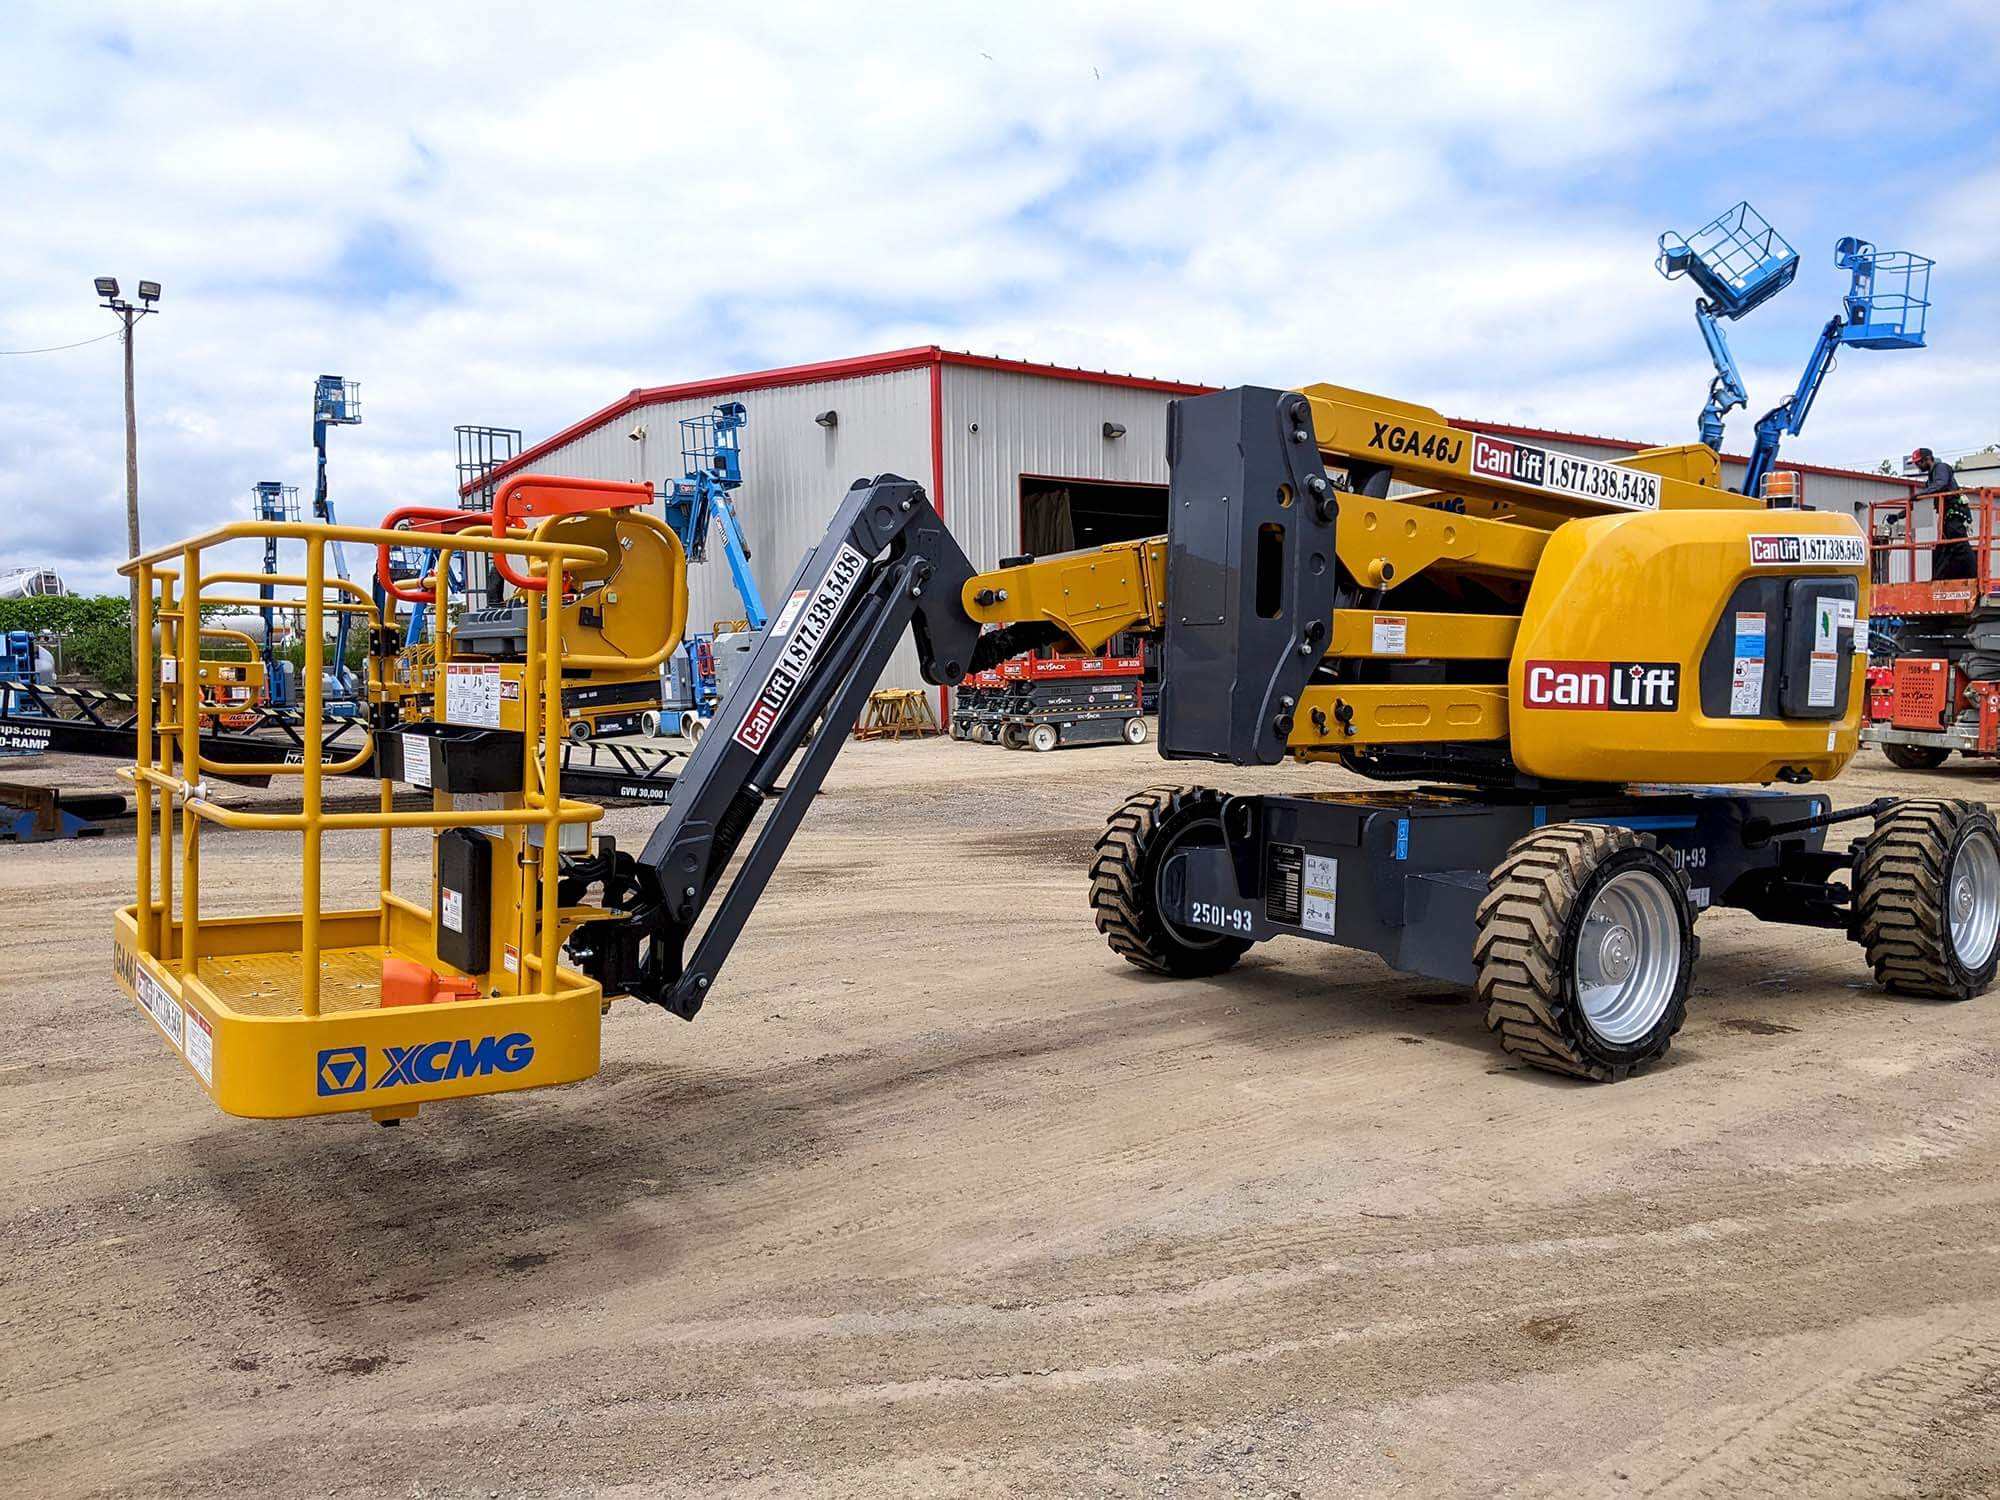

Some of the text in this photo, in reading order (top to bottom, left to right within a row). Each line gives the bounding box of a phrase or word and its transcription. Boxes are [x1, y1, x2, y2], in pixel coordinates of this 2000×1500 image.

[1368, 422, 1463, 464] XGA46J
[1548, 457, 1657, 506] 1.877.338.5438
[1802, 539, 1864, 561] 1.877.338.5438
[782, 551, 861, 674] 1.877.338.5438
[1036, 662, 1066, 671] SKYJACK
[1048, 696, 1072, 705] SKYJACK
[1901, 691, 1933, 700] SKYJACK
[621, 787, 637, 797] GVW
[638, 788, 663, 799] 30,000
[1674, 847, 1706, 869] 01-93
[1192, 902, 1252, 932] 2501-93
[372, 1032, 535, 1089] XCMG
